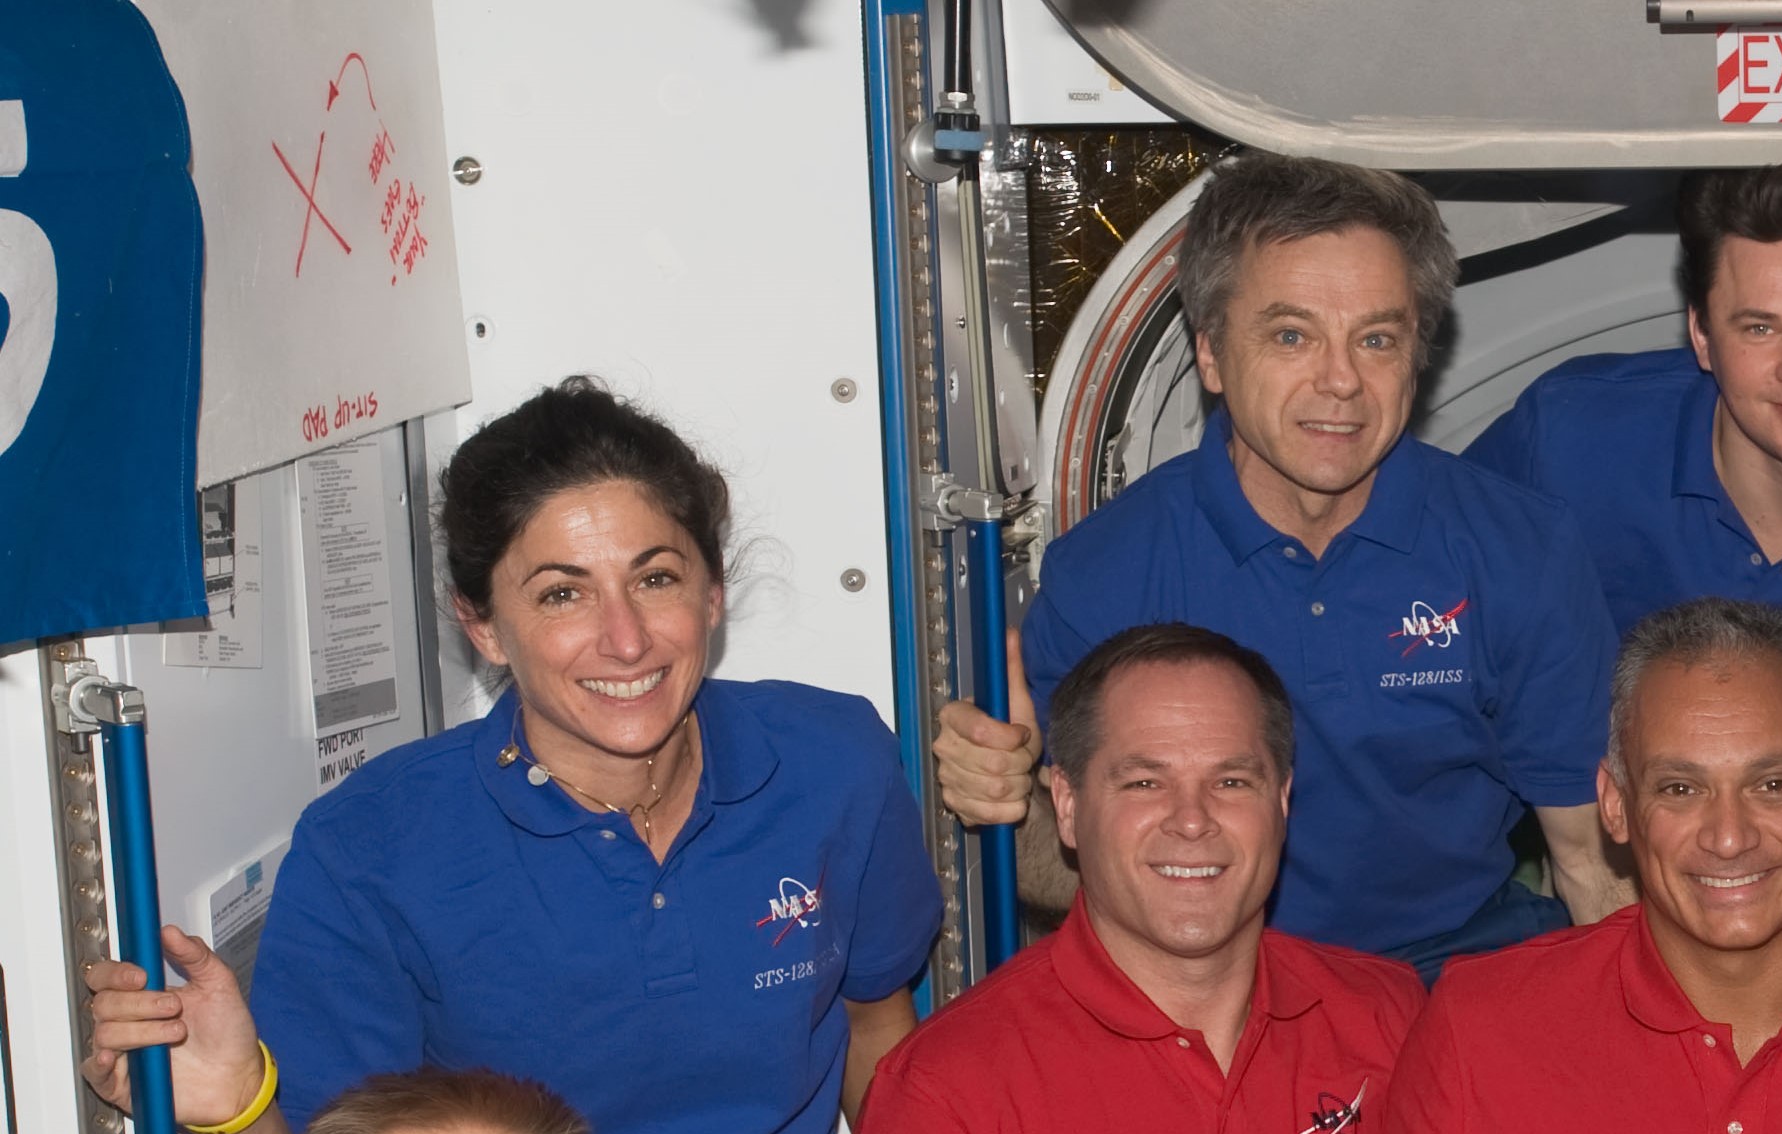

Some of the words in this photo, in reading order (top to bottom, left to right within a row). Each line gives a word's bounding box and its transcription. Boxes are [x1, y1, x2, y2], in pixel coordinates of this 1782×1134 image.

[302, 404, 329, 442] PAD
[1402, 616, 1461, 636] NASA
[1380, 669, 1463, 687] STS-128/ISS
[318, 735, 339, 759] FWD
[340, 728, 364, 749] PORT
[320, 762, 336, 785] IMV
[768, 889, 821, 921] NAS
